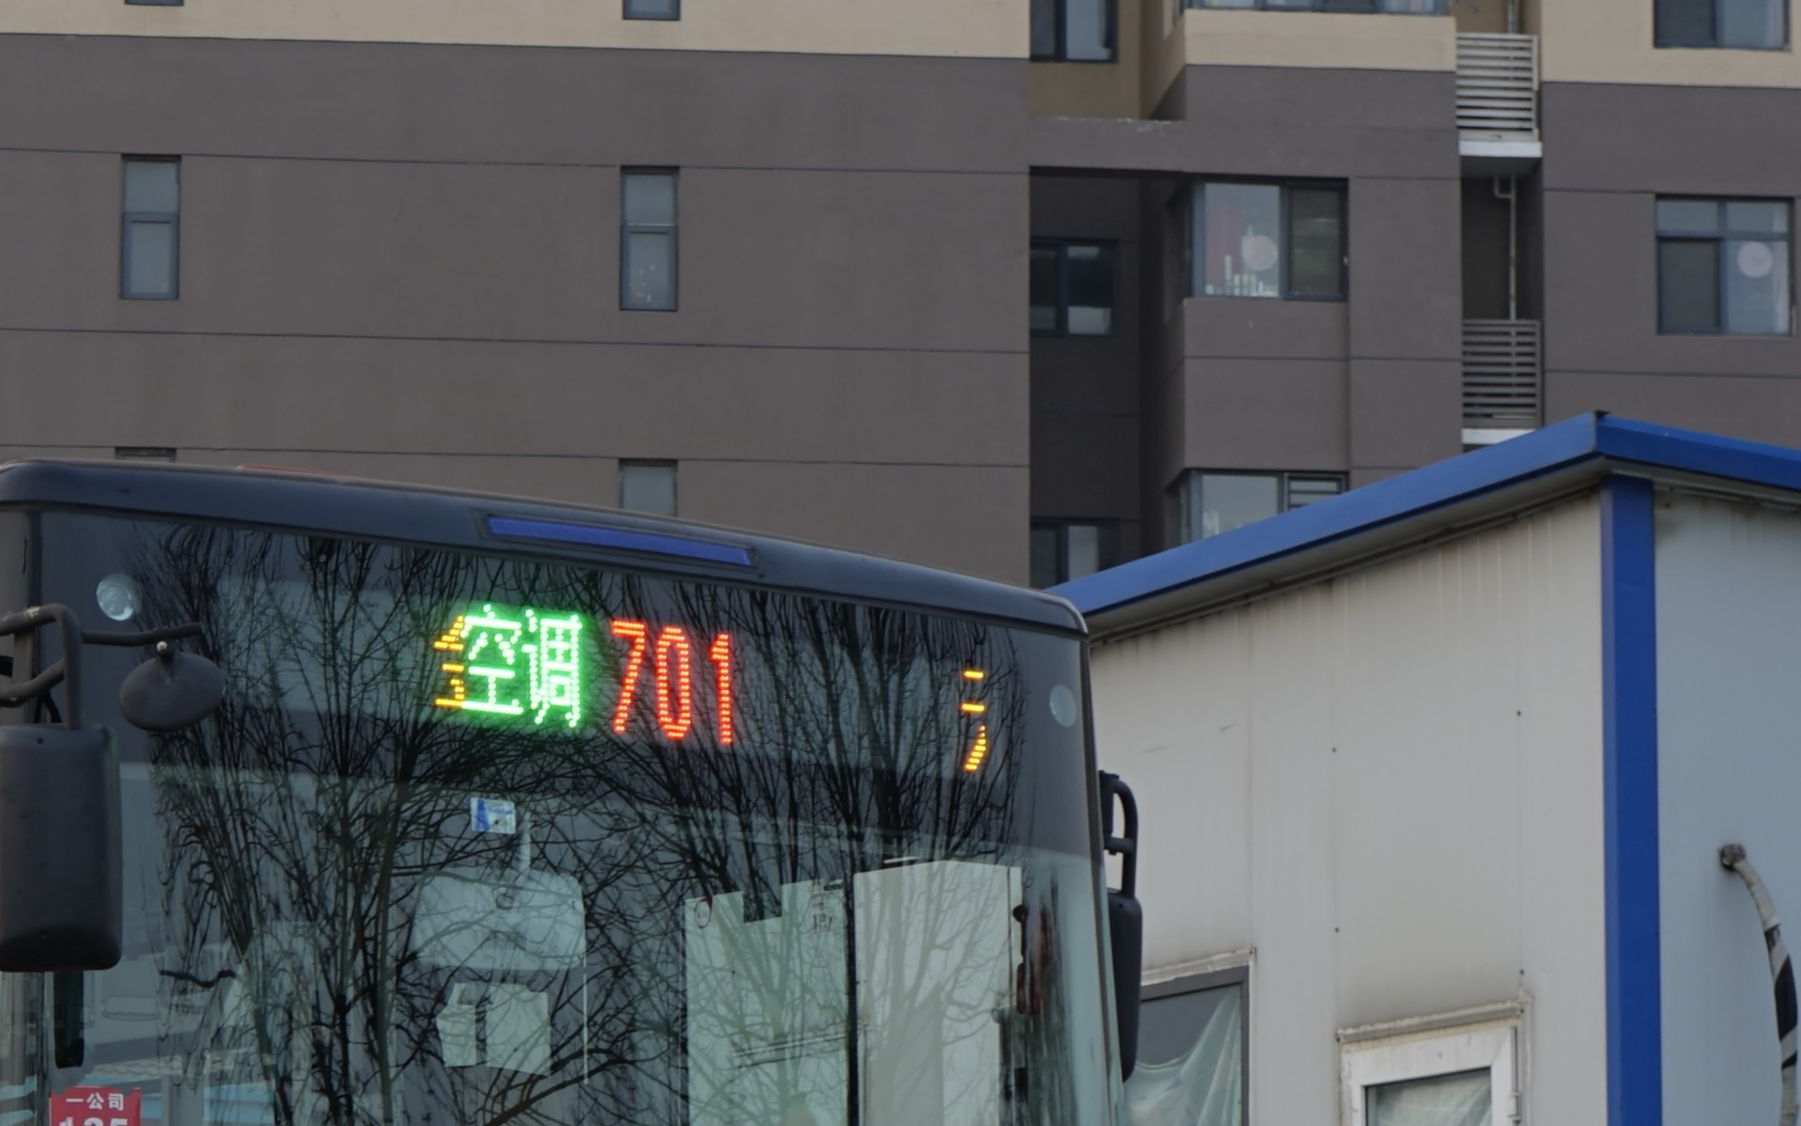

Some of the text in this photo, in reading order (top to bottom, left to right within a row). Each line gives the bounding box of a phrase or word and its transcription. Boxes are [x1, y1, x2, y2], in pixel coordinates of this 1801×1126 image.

[460, 604, 583, 728] 空调
[610, 618, 734, 745] 701
[66, 1092, 125, 1111] 一公司
